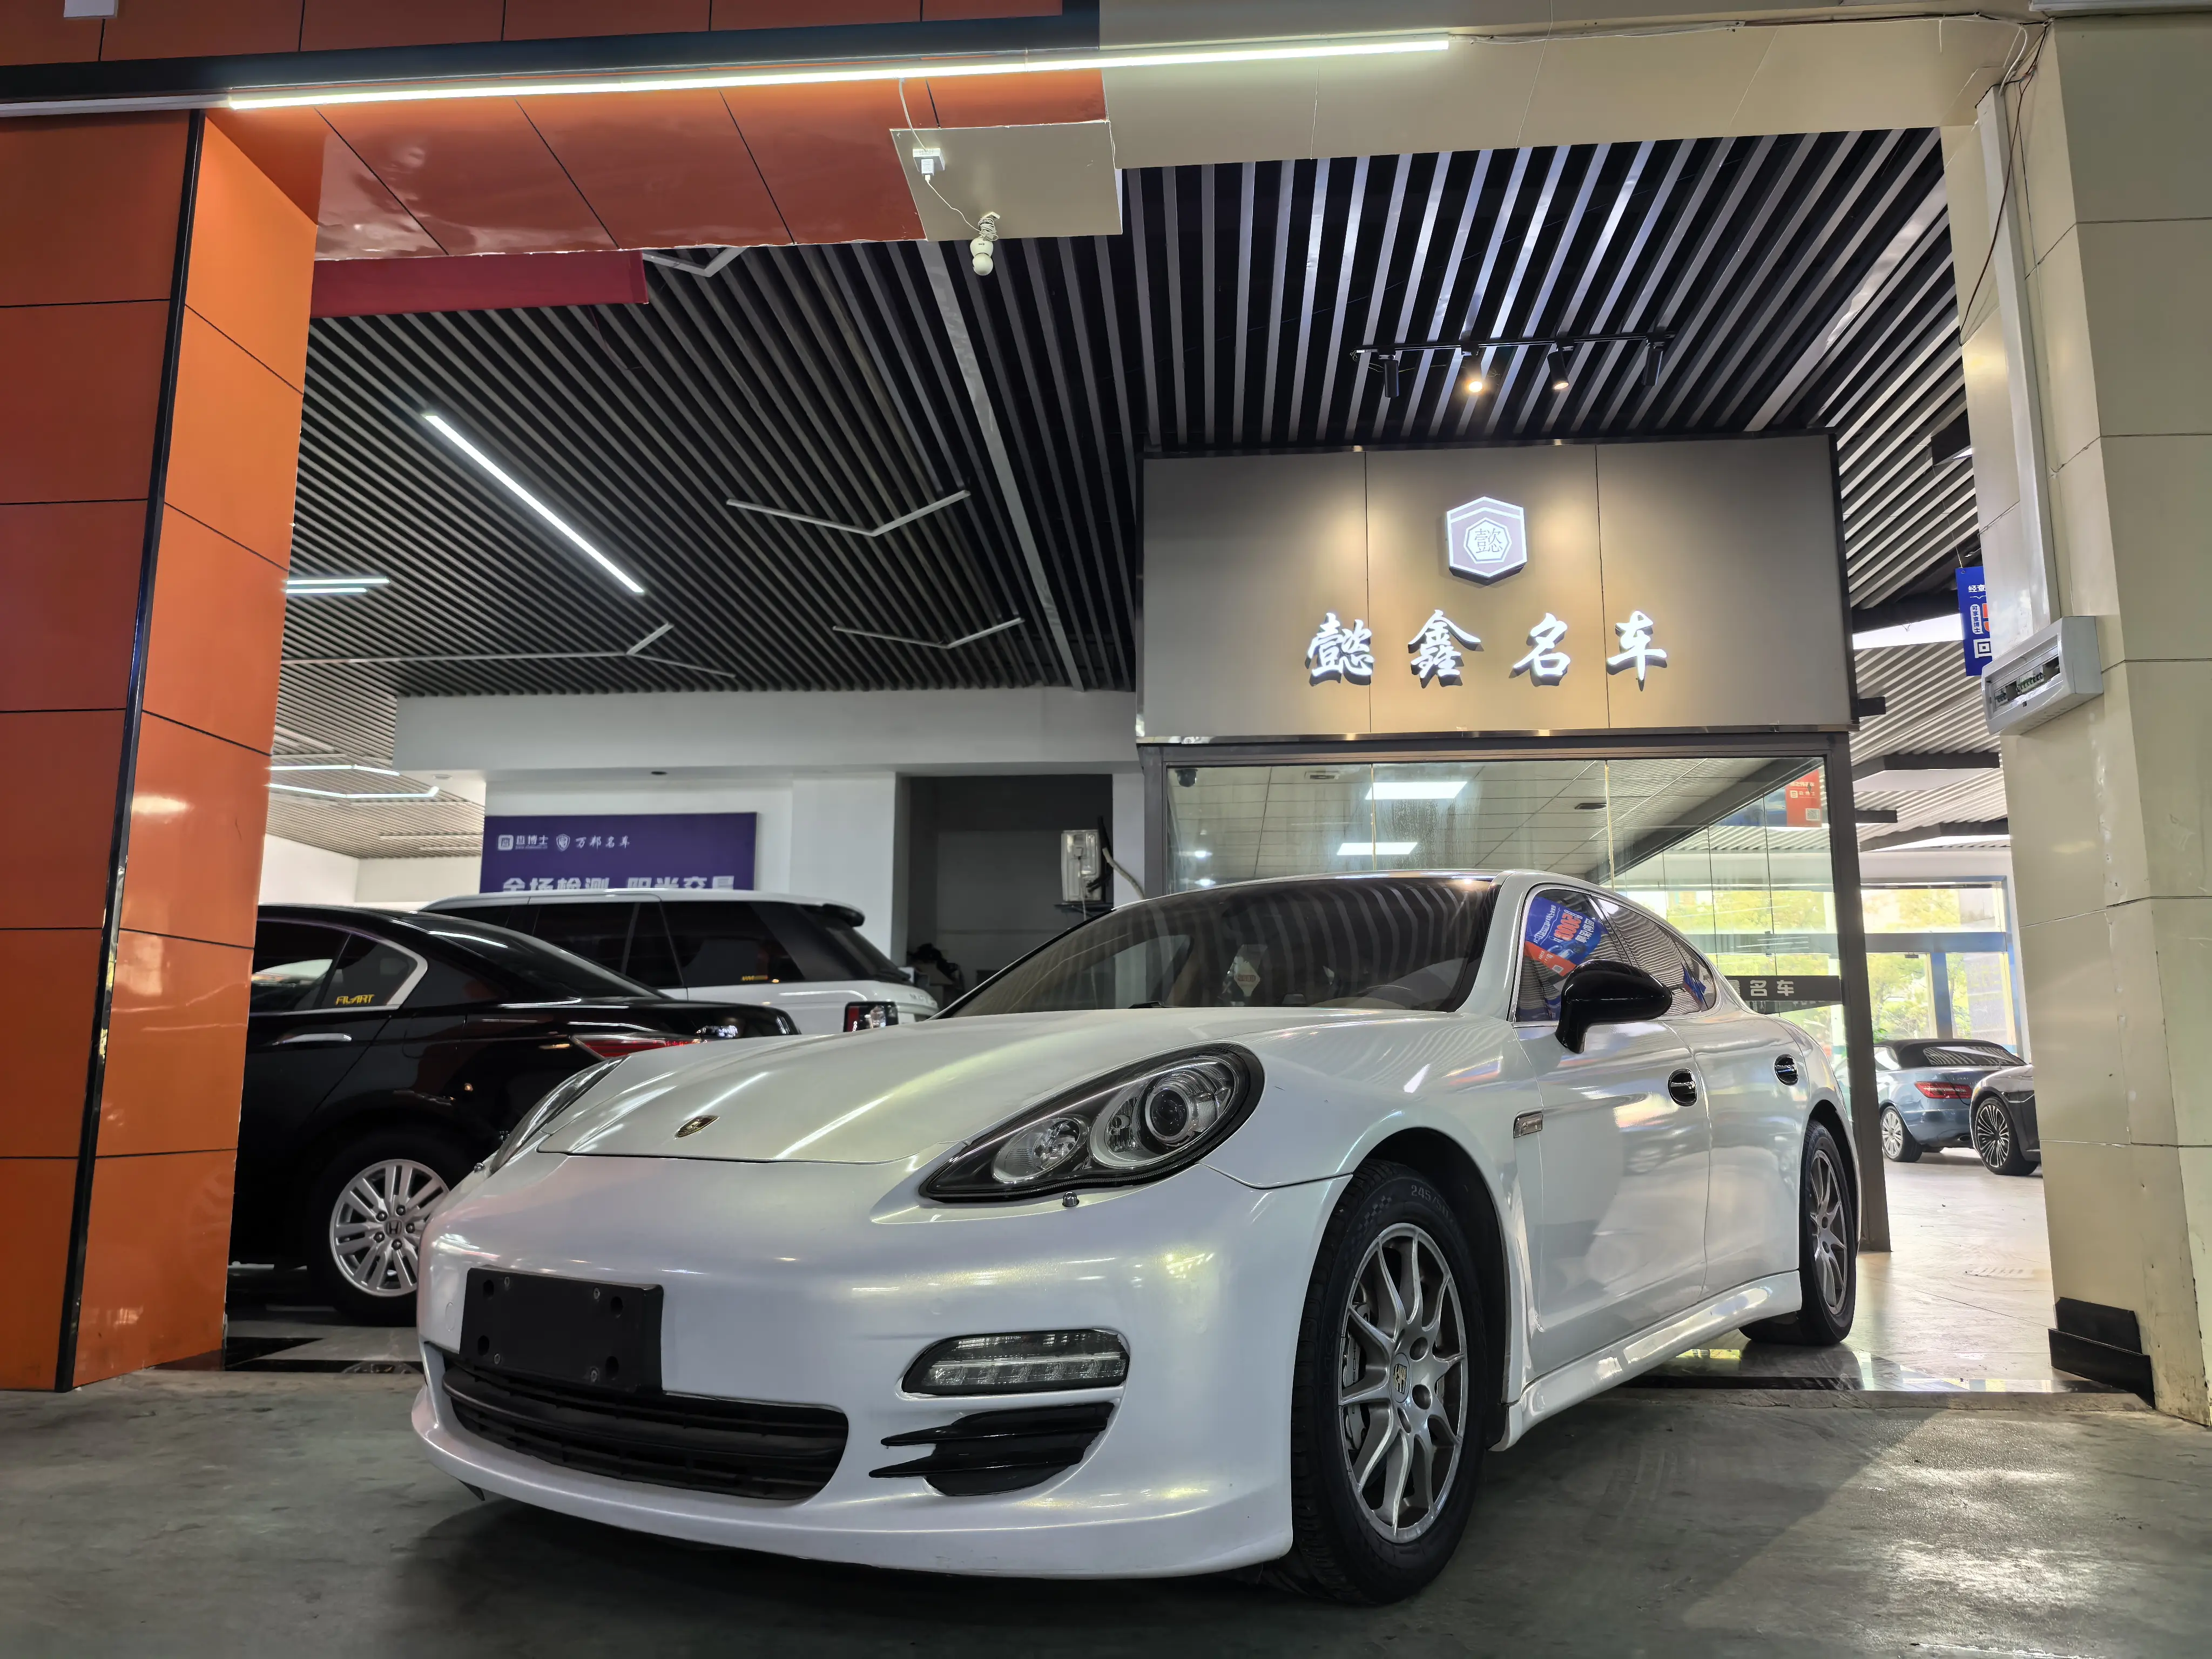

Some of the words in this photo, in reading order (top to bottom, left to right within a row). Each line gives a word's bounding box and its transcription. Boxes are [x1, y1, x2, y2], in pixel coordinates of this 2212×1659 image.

[1474, 528, 1503, 554] 懿
[1306, 609, 1668, 685] 懿鑫名车
